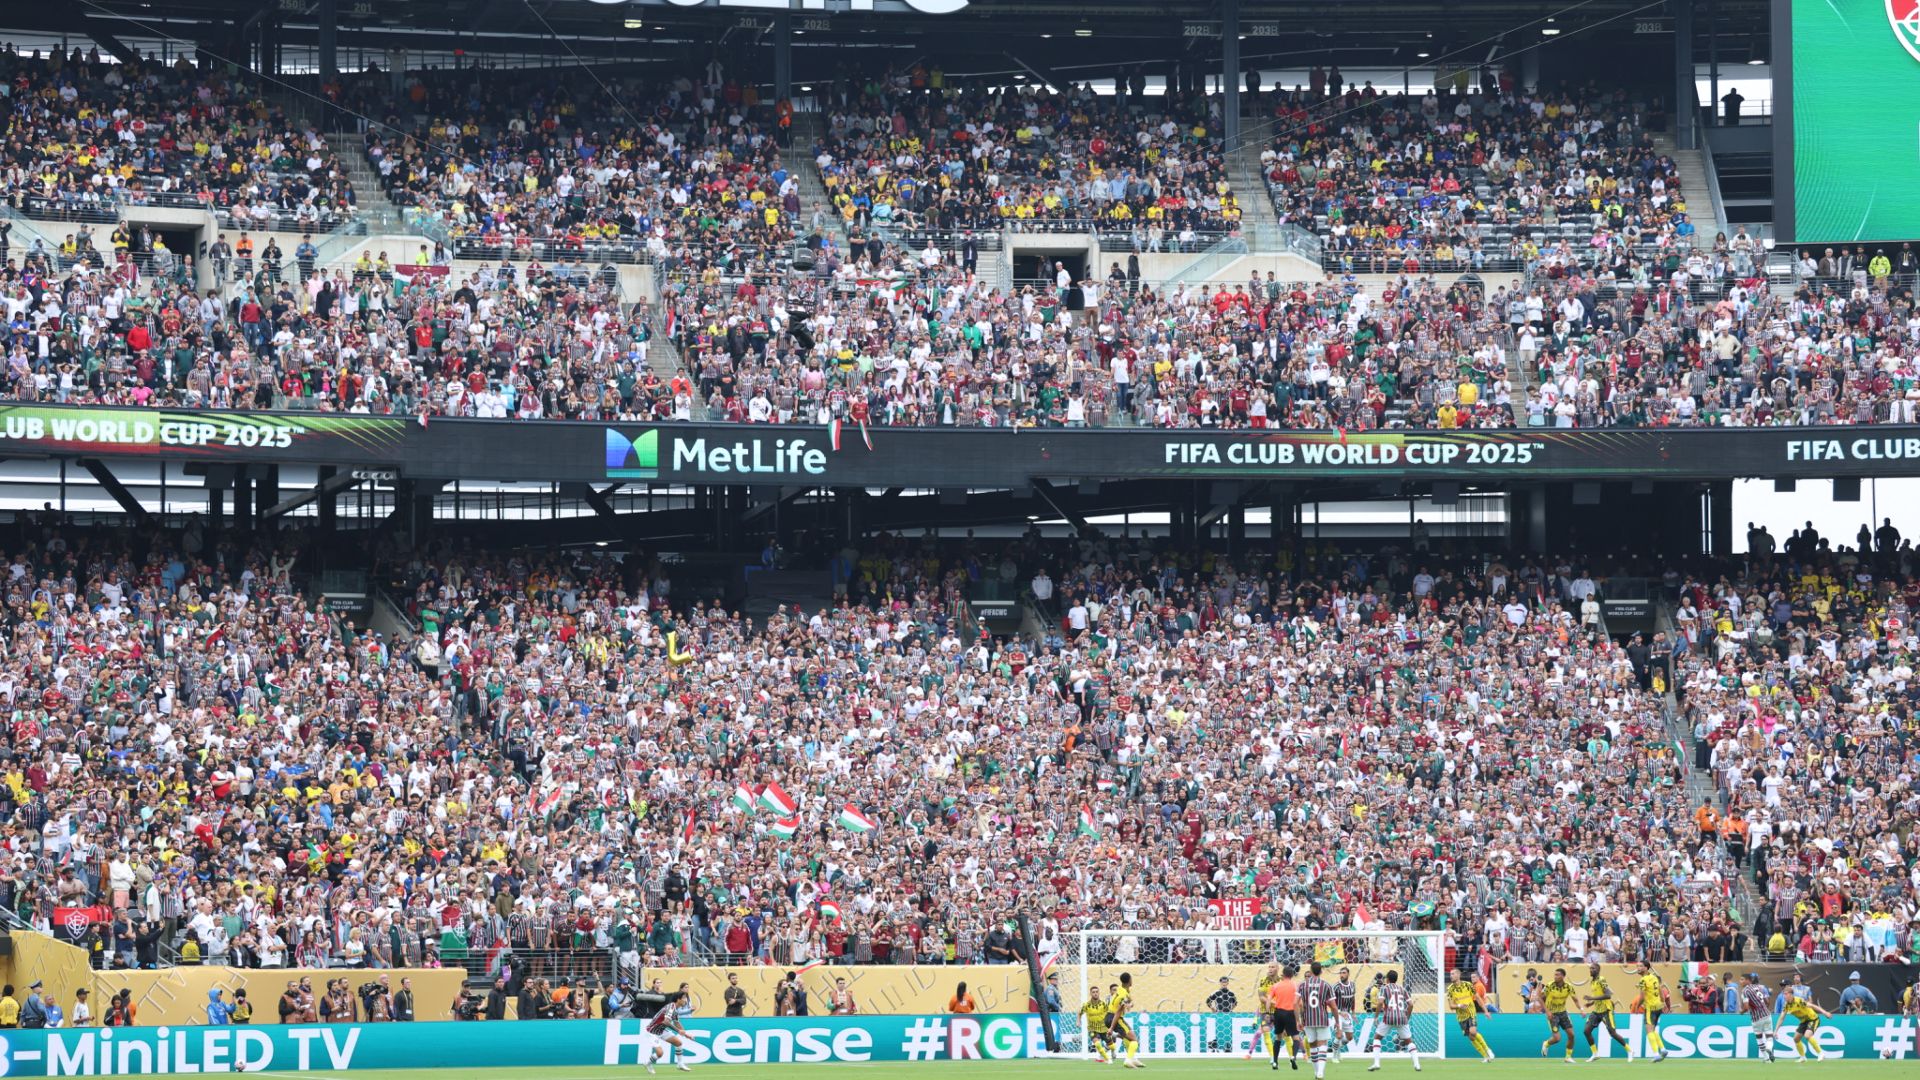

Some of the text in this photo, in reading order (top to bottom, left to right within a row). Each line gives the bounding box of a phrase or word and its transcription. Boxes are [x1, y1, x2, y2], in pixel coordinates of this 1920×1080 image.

[354, 3, 372, 13] 201
[740, 18, 757, 27] 201
[804, 20, 830, 30] 202B
[1184, 26, 1209, 35] 202B
[1252, 26, 1278, 36] 203B
[50, 418, 154, 443] WORLD
[160, 423, 216, 445] CUP
[673, 438, 826, 474] MetLife
[1165, 443, 1221, 463] FIFA
[1227, 443, 1295, 464] CLUB
[1300, 443, 1399, 464] WORLD
[1405, 443, 1459, 463] CUP
[1787, 439, 1920, 461] FIFA CLUB
[1223, 901, 1252, 916] THE
[1309, 991, 1319, 1008] 6
[1873, 1018, 1916, 1059] #
[288, 1027, 362, 1070] TV
